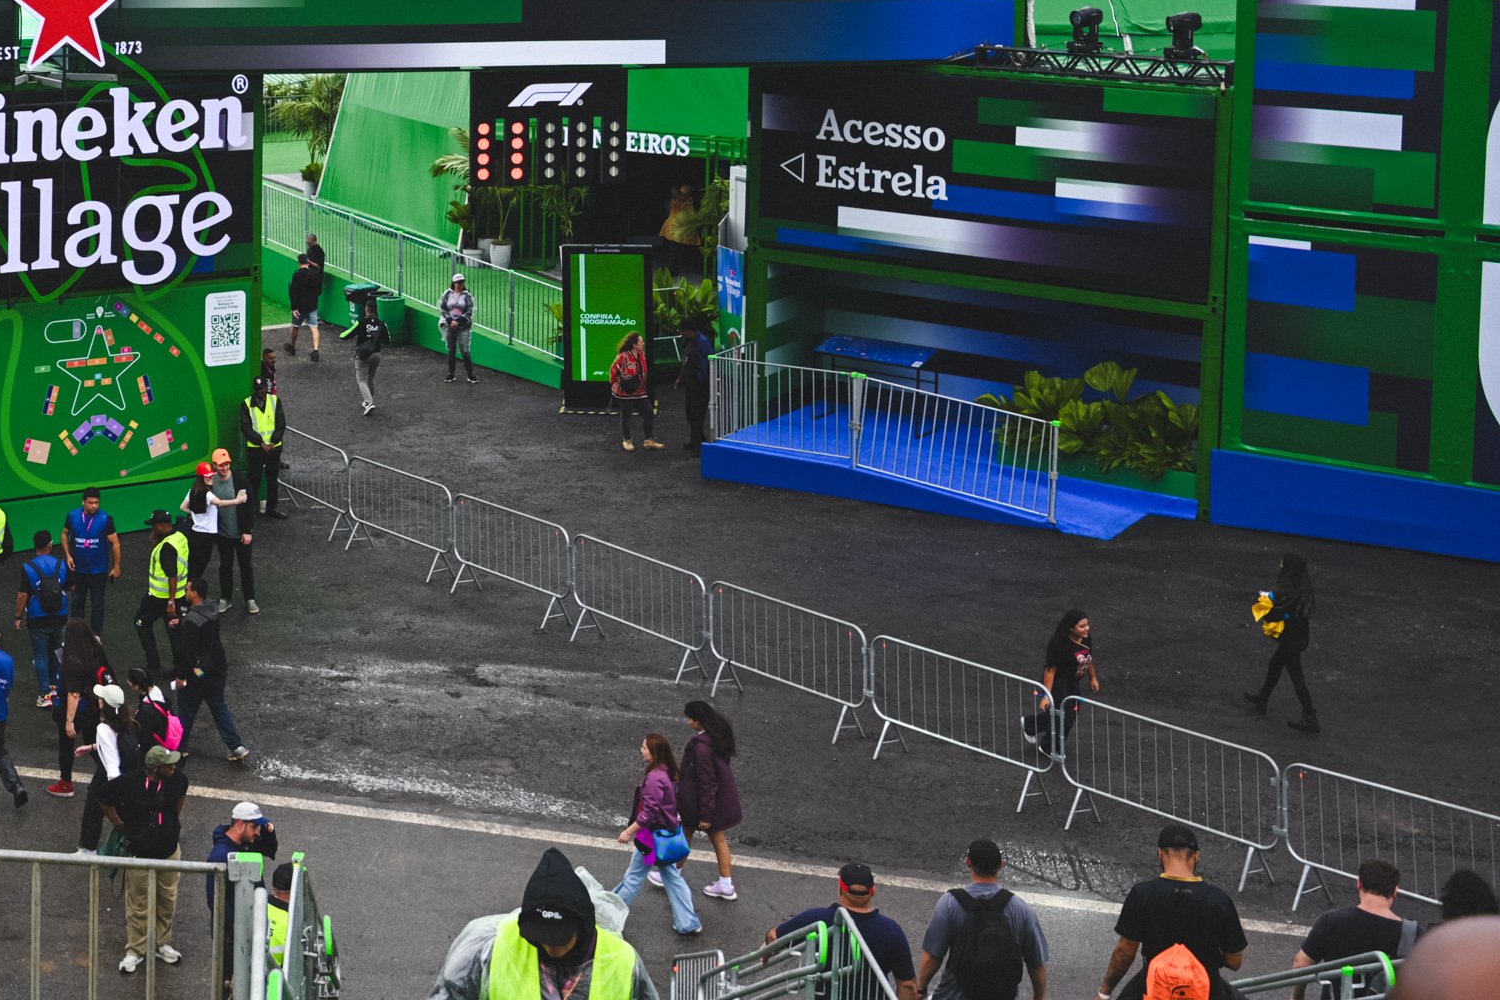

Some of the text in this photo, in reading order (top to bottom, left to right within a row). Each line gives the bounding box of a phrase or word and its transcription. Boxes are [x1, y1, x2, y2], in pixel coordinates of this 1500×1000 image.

[115, 41, 143, 56] 1873
[507, 82, 593, 108] F1
[815, 108, 946, 152] Acesso
[815, 154, 949, 201] Estrela
[580, 318, 637, 326] PROGRAMAÇÃO
